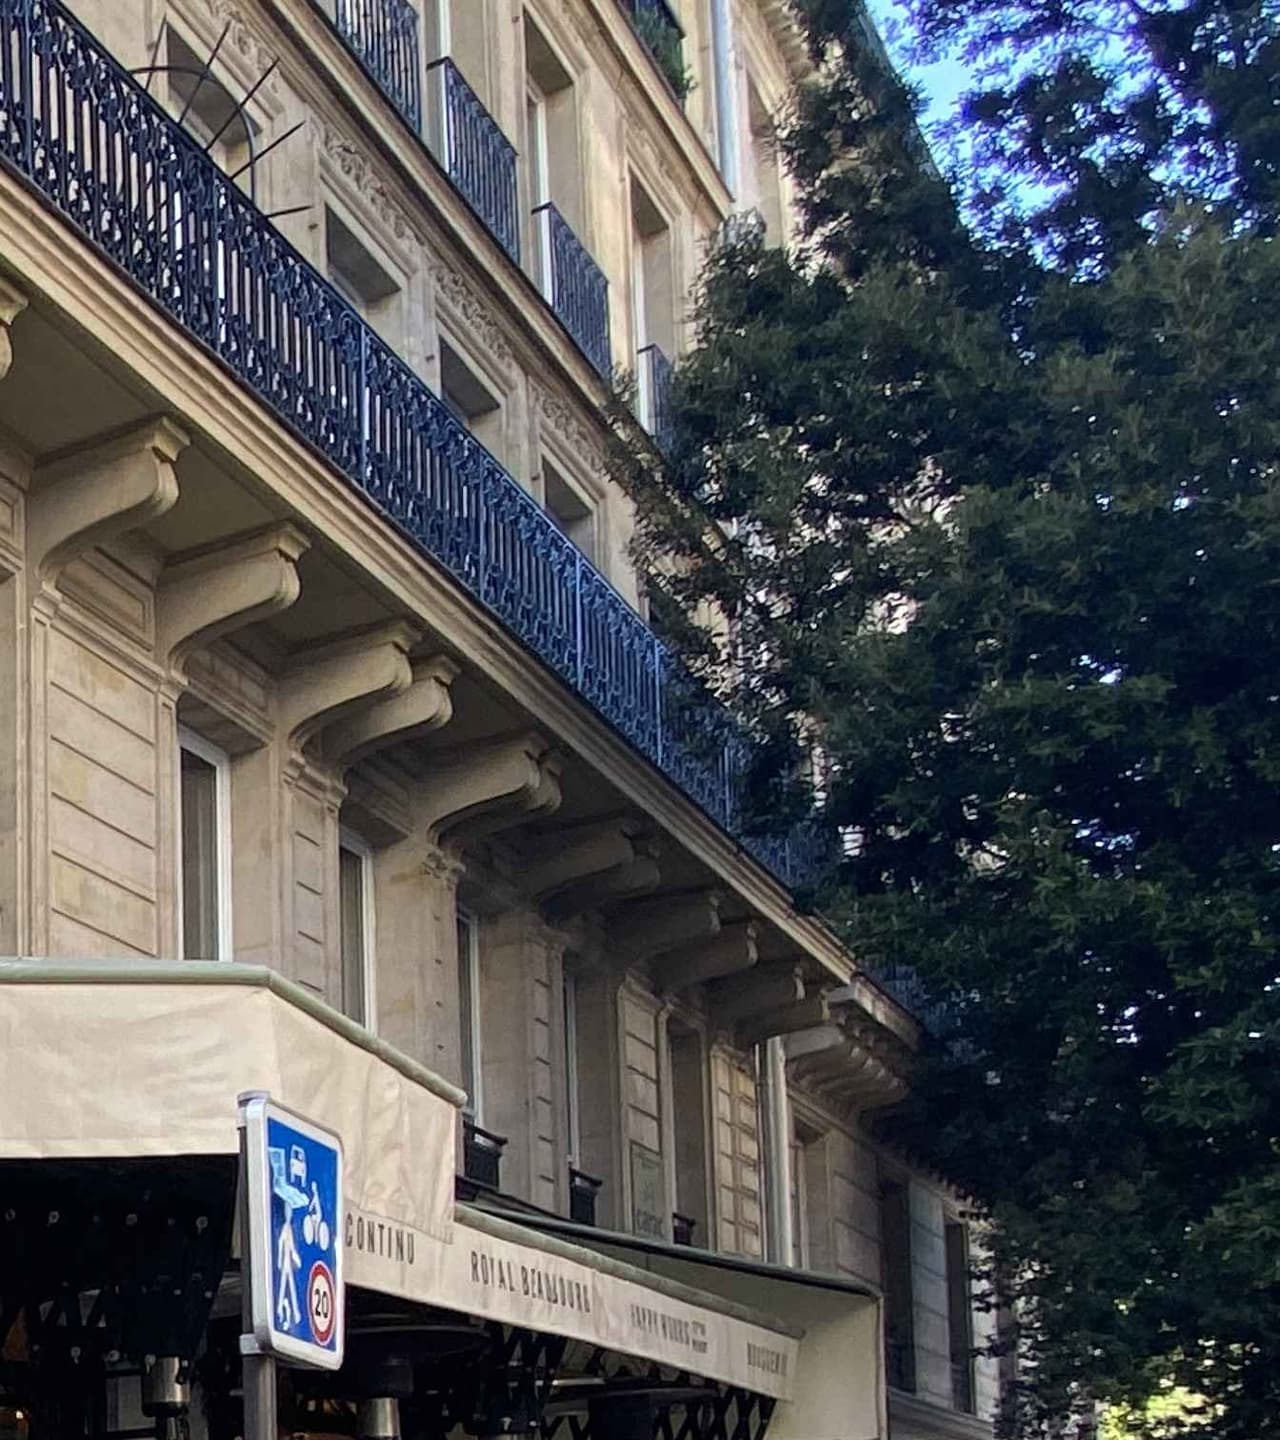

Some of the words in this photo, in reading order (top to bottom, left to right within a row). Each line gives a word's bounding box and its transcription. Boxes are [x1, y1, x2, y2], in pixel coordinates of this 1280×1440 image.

[345, 1212, 415, 1265] CONTINU
[314, 1288, 330, 1319] 20
[471, 1251, 515, 1292] ROYAL
[521, 1265, 591, 1313] BEAUBOURG
